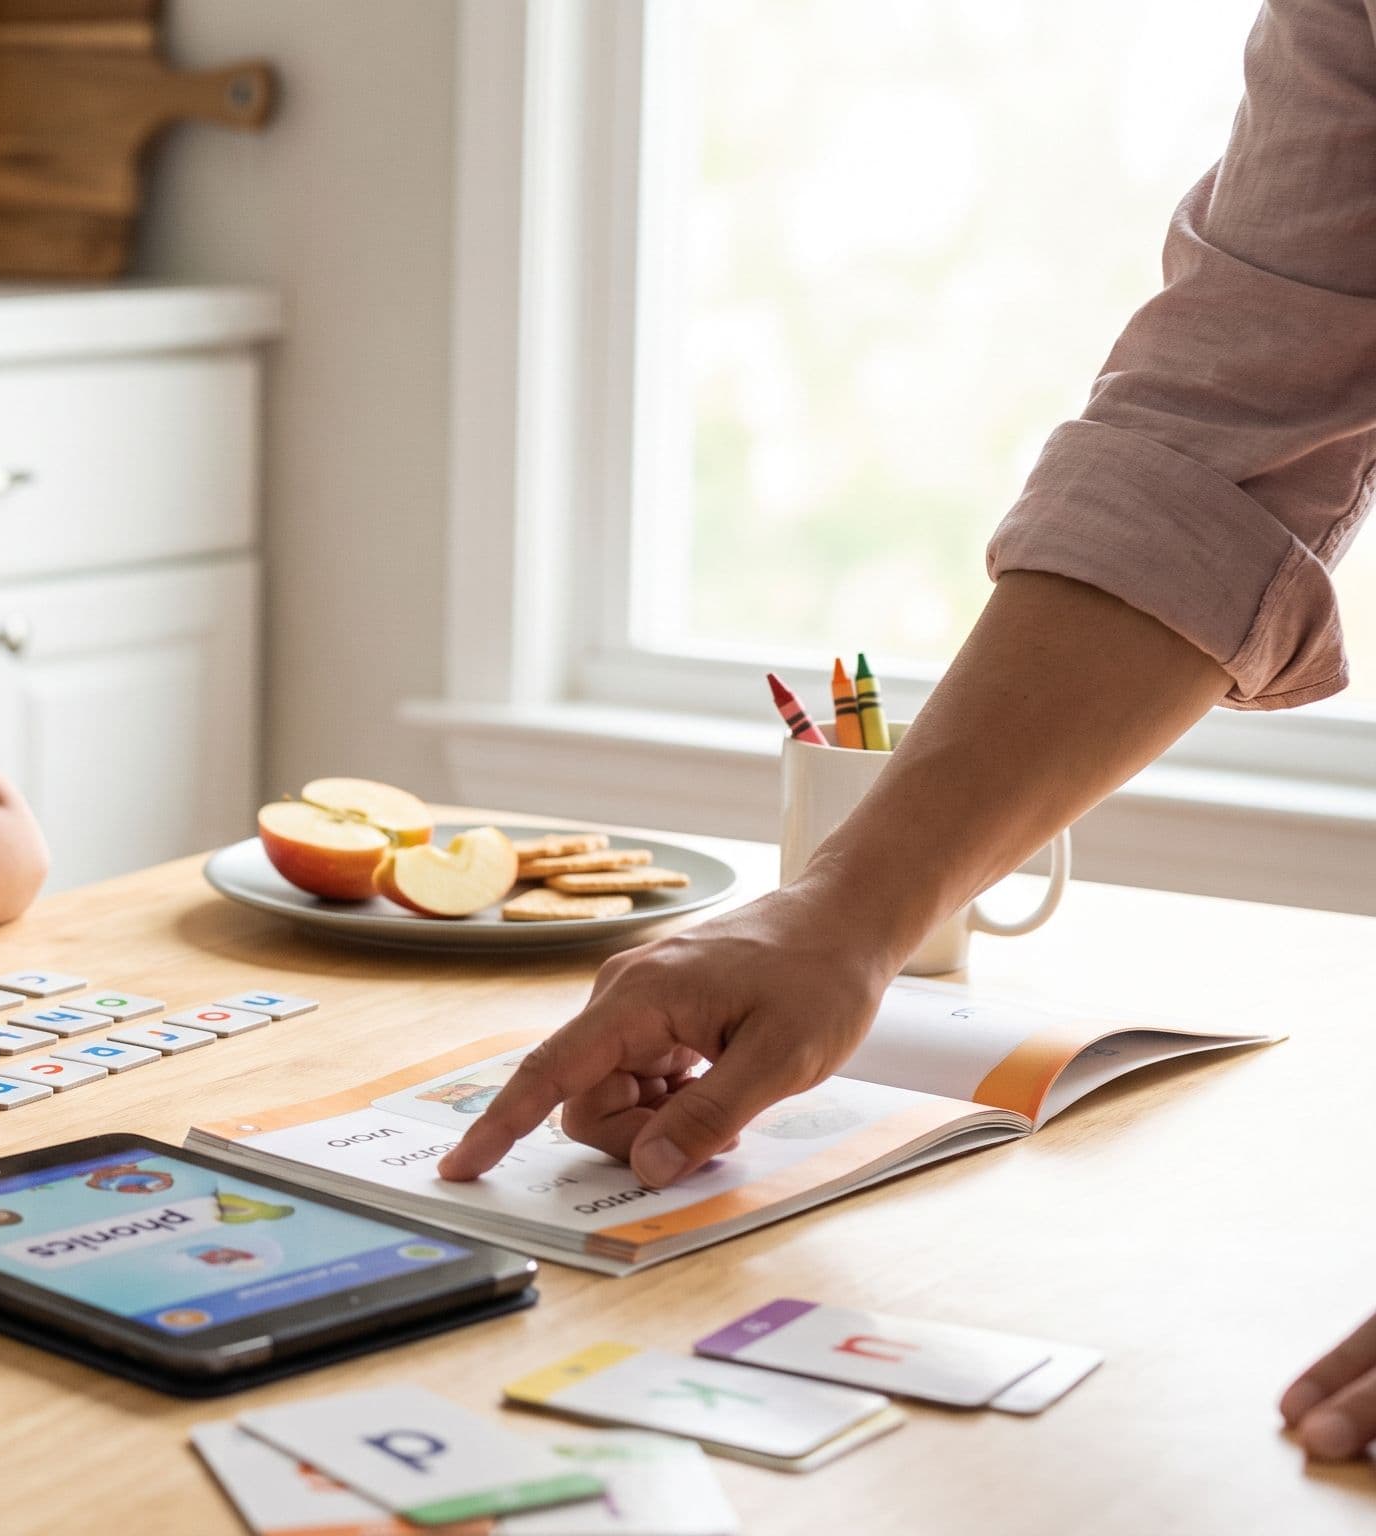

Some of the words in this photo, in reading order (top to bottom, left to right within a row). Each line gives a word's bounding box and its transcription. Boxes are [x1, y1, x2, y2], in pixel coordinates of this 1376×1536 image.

[95, 997, 128, 1008] o
[196, 1010, 231, 1022] o
[26, 1208, 193, 1257] phonics
